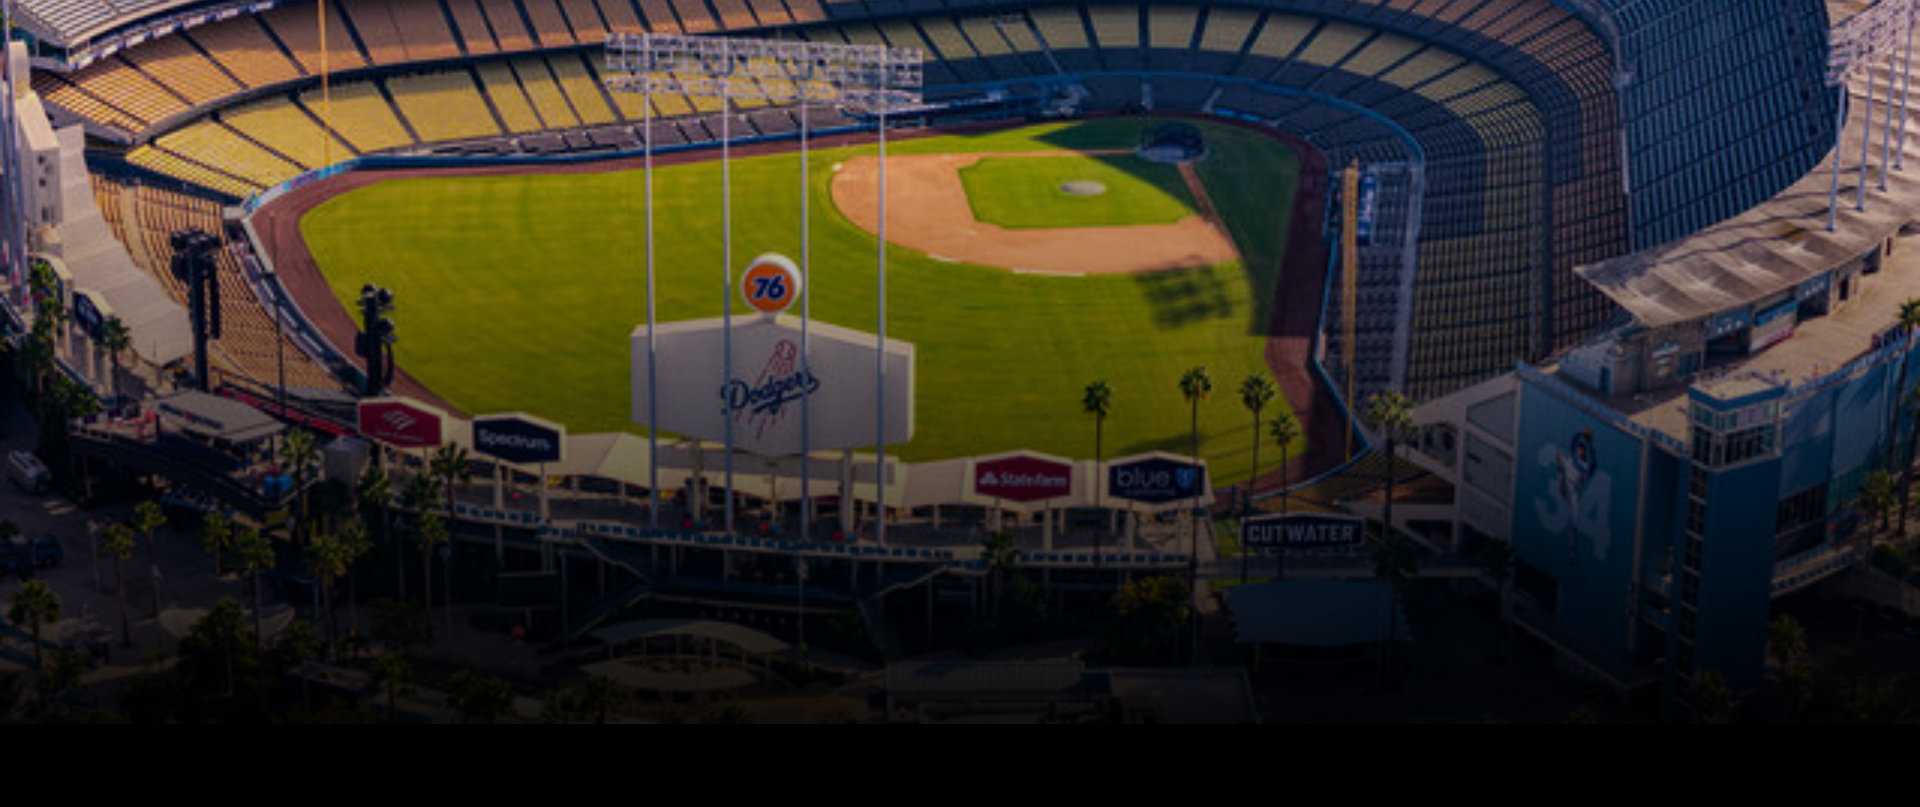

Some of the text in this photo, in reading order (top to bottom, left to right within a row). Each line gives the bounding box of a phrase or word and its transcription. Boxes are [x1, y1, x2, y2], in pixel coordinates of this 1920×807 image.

[754, 275, 786, 300] 76
[720, 367, 820, 414] Dodgers
[477, 428, 550, 450] Spectrum
[1117, 467, 1170, 487] blue
[1532, 443, 1612, 564] 34
[1247, 524, 1354, 542] CUTWATER
